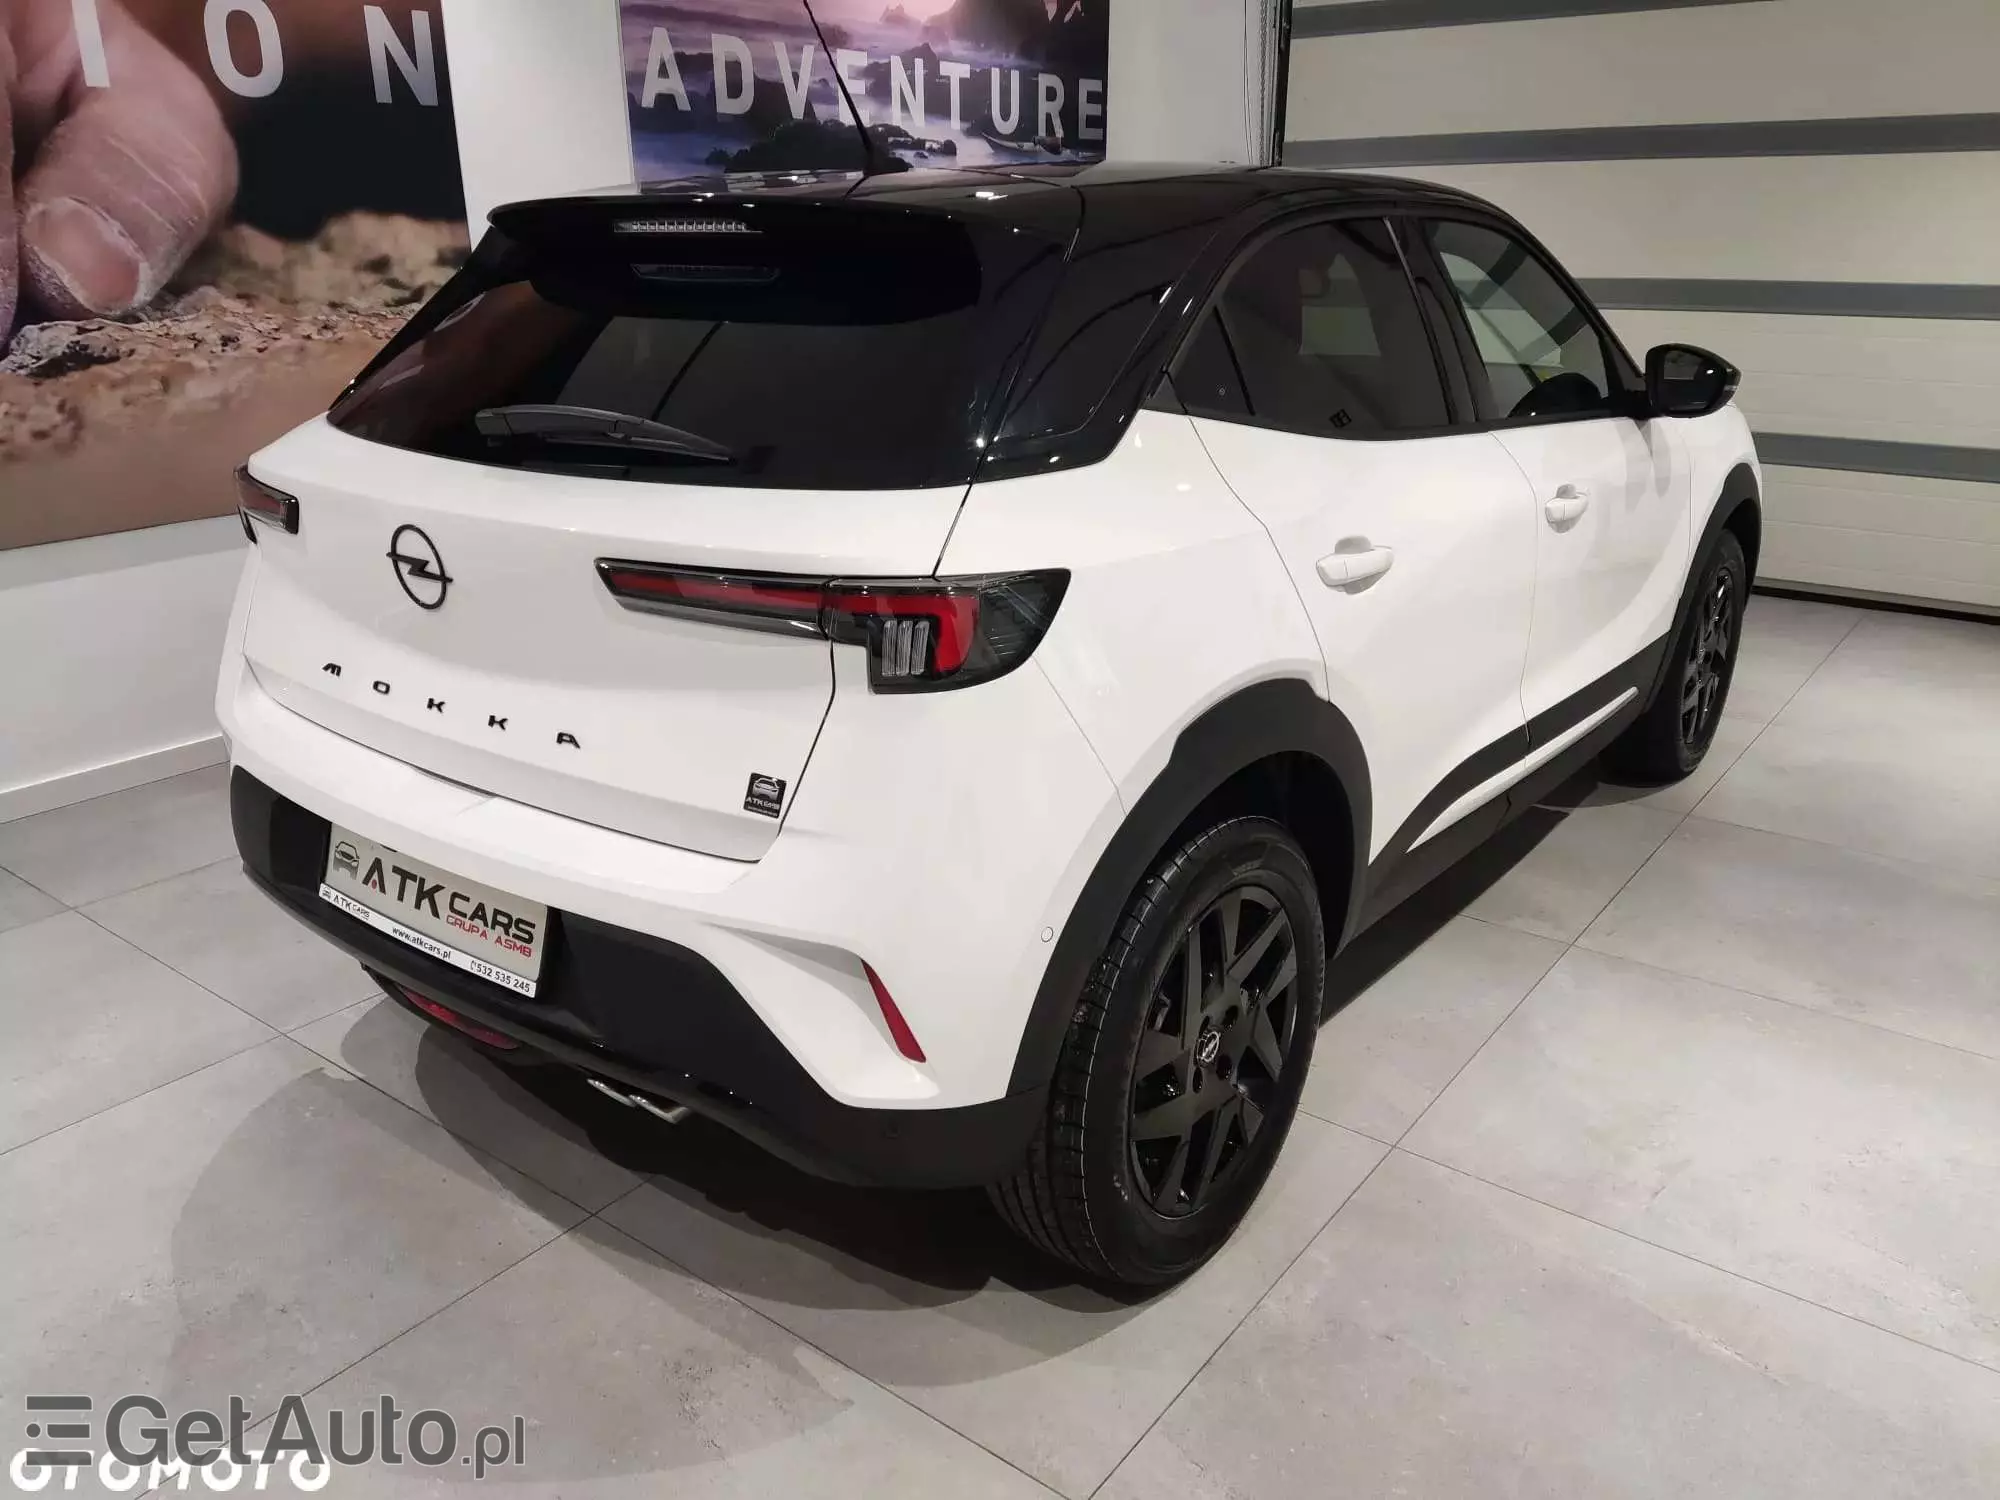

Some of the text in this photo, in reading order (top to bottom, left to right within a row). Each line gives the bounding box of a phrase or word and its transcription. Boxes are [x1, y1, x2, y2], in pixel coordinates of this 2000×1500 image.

[641, 26, 1103, 141] ADVENTURE
[322, 662, 581, 749] MOKKA
[333, 895, 351, 911] ATK
[362, 857, 536, 945] ATK CARS
[392, 927, 451, 959] www.atkcars.pl
[494, 935, 532, 958] ASMB
[476, 963, 530, 993] 532 535 245
